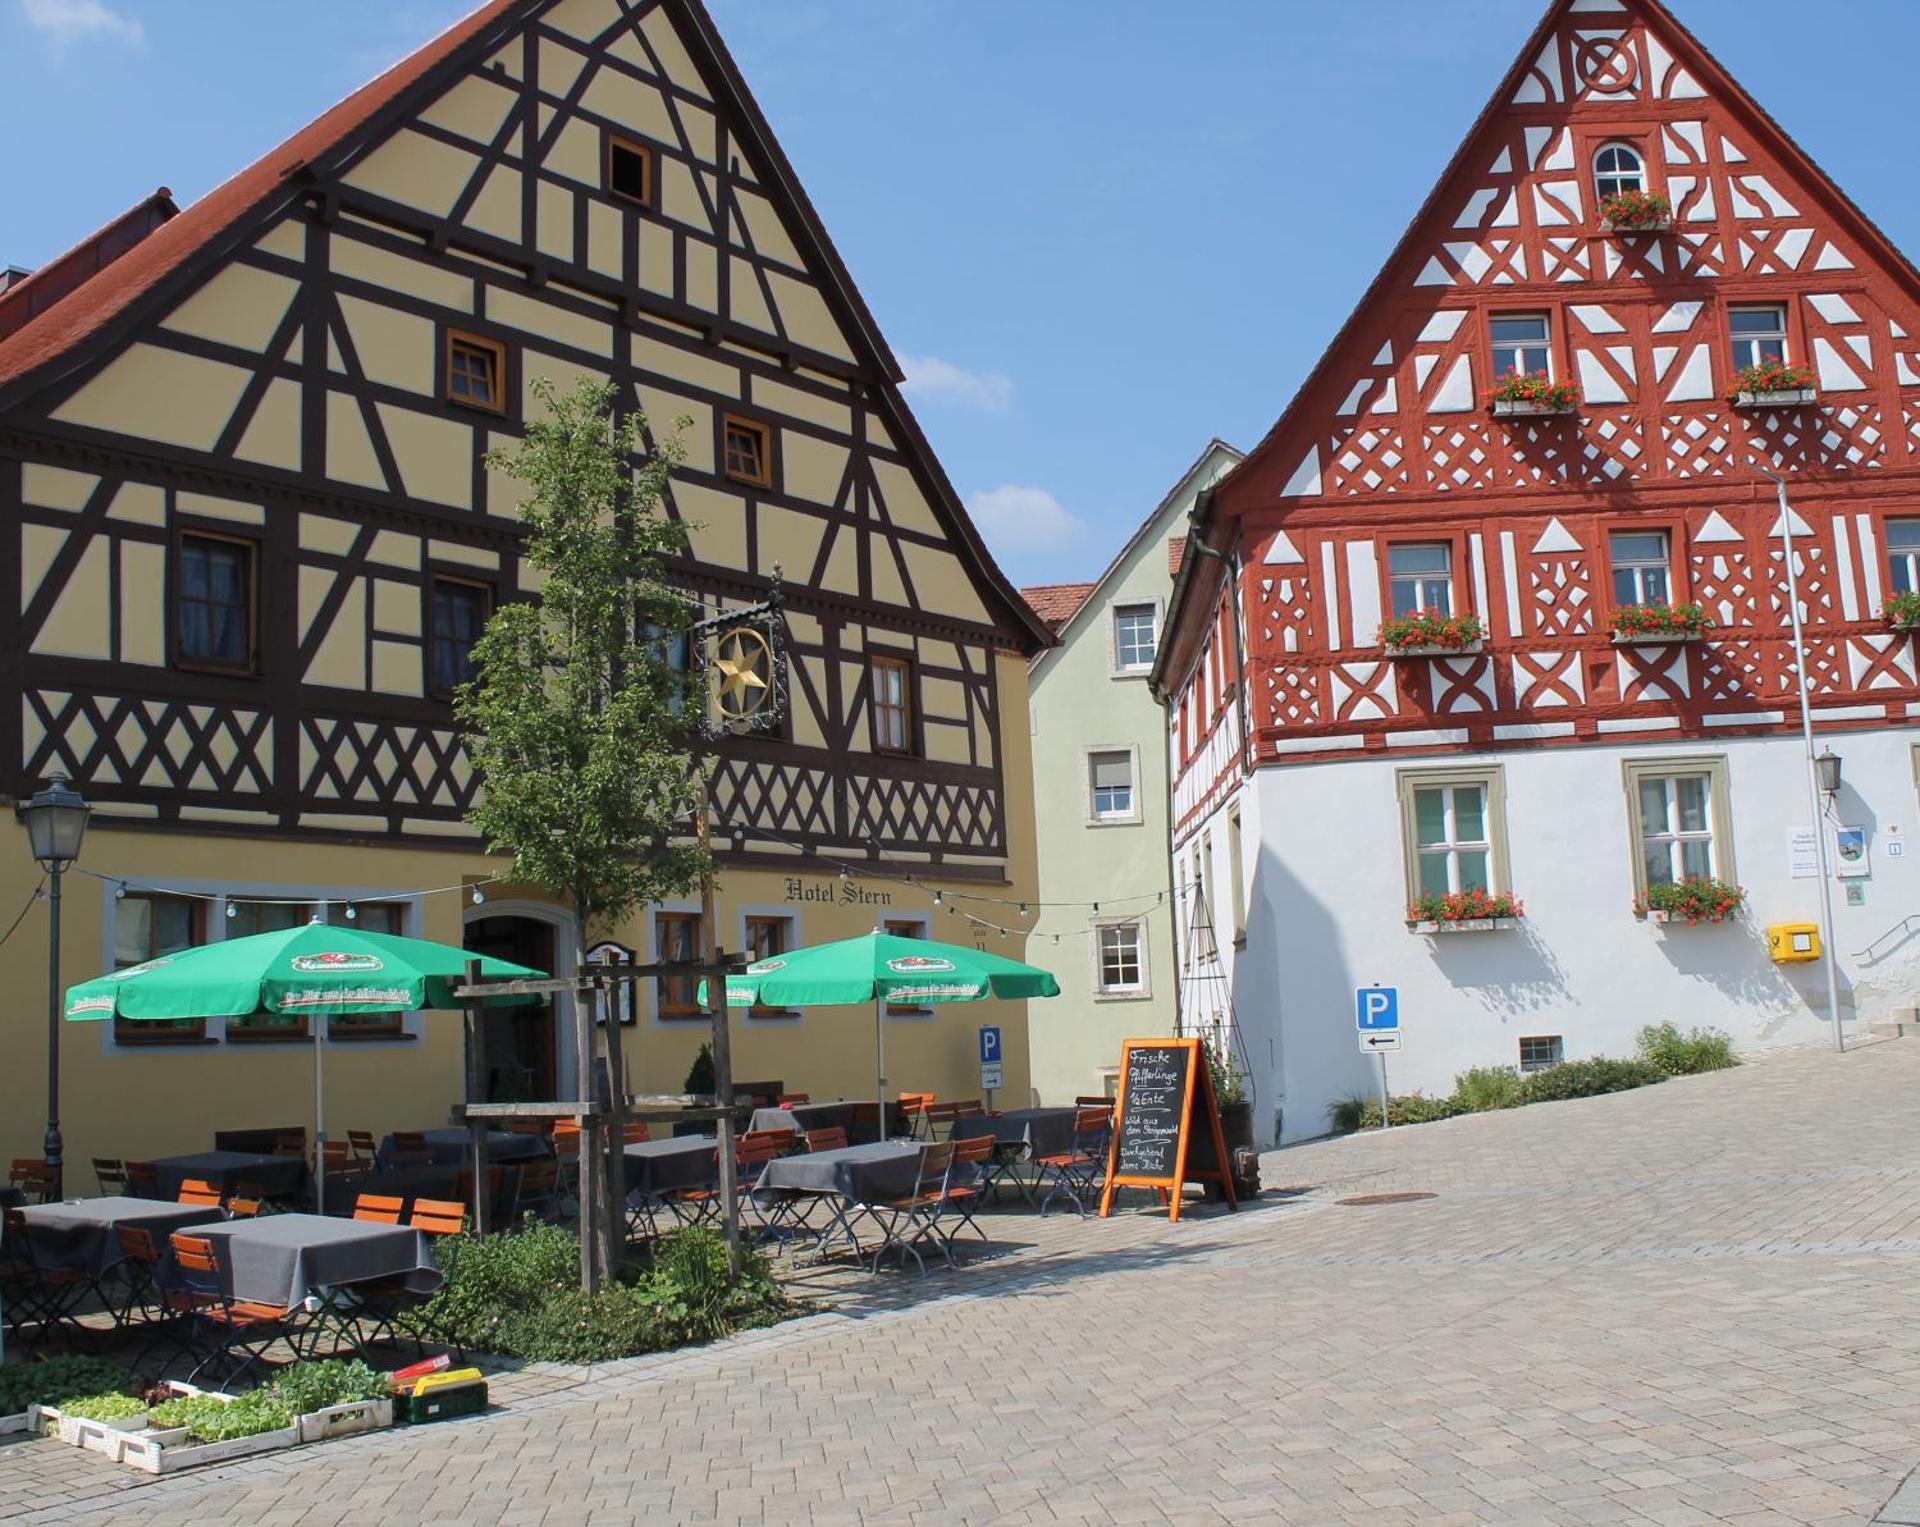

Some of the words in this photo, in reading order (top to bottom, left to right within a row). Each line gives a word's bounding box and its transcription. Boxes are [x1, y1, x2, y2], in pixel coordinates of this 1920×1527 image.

[784, 877, 834, 902] Hotel
[839, 880, 892, 907] Stern
[1366, 992, 1389, 1024] P
[984, 1031, 996, 1058] P
[1129, 1049, 1170, 1064] Frische
[1129, 1067, 1177, 1085] Pfifferlinge
[1141, 1091, 1165, 1105] Ente
